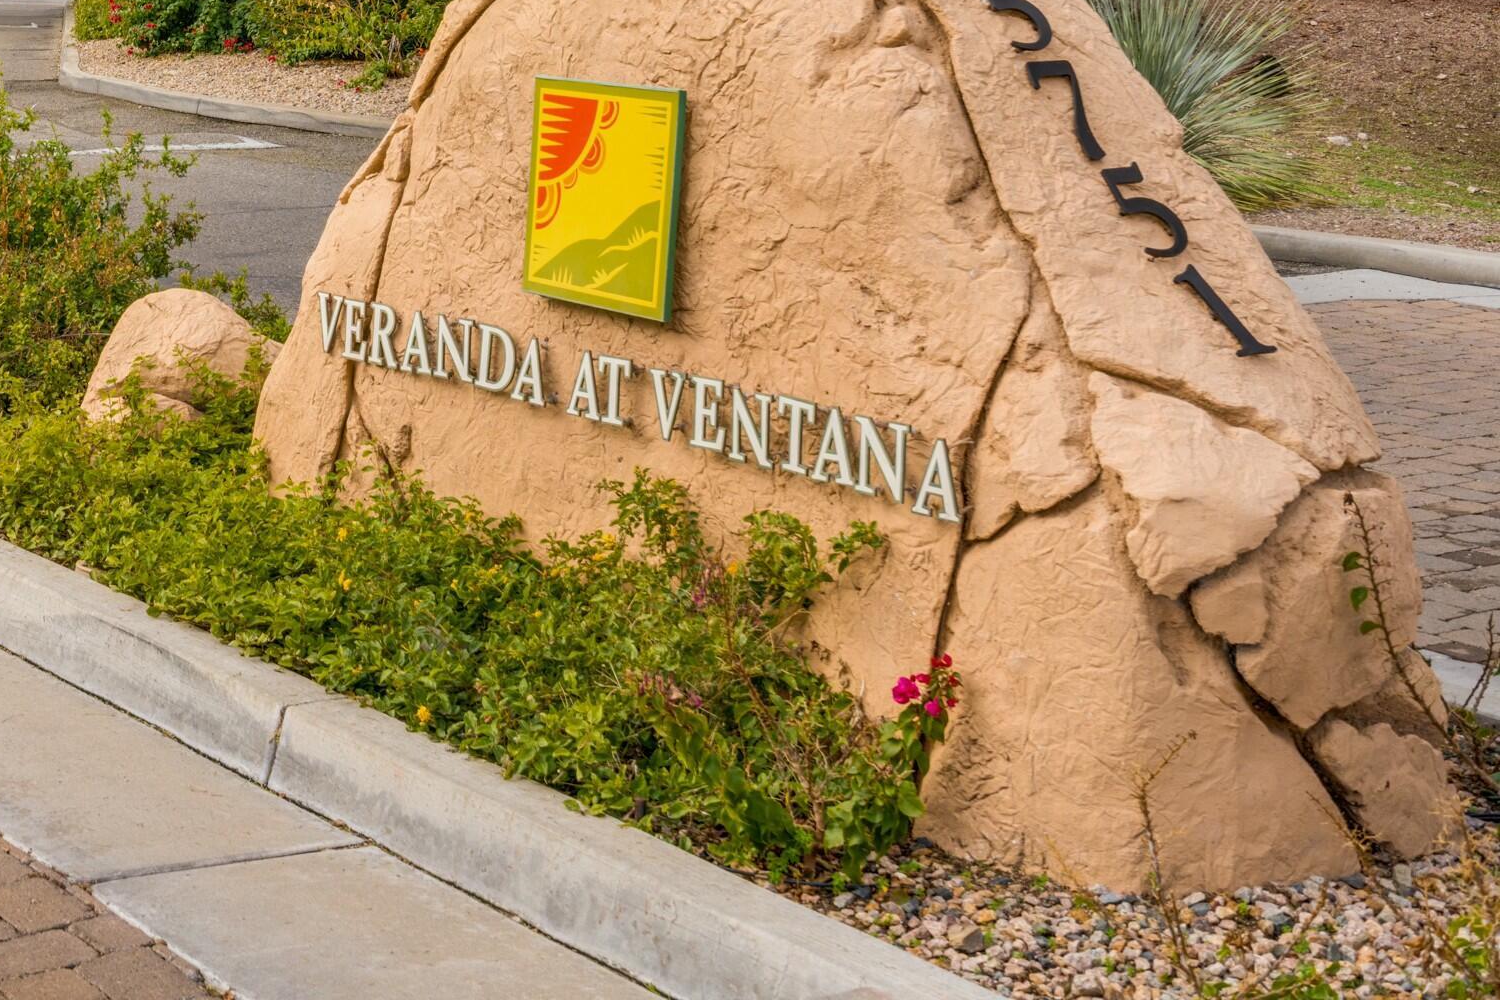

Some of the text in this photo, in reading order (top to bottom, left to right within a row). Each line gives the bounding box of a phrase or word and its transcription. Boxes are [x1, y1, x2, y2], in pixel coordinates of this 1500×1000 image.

[318, 291, 962, 523] VERANDA AT VENTANA
